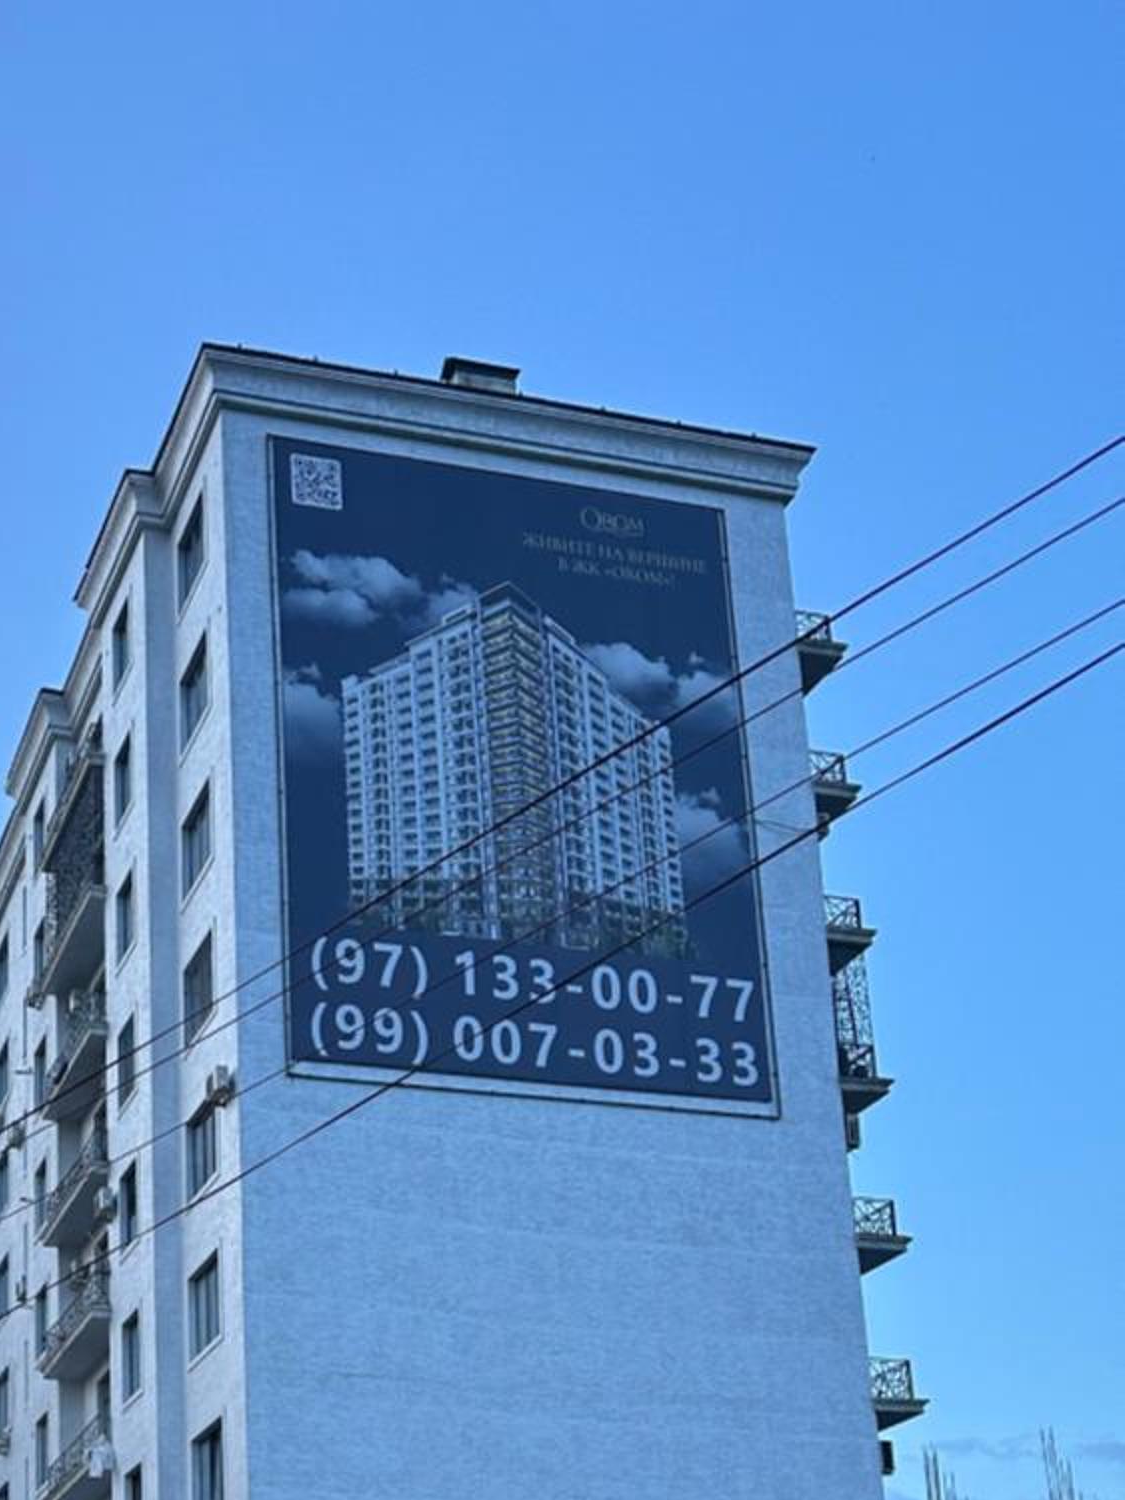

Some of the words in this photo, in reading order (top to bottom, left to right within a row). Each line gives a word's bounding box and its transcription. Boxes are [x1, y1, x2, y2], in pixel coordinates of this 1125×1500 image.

[310, 935, 428, 999] (97)
[455, 949, 754, 1022] 133-00-77
[310, 1002, 429, 1065] (99)
[454, 1015, 759, 1087] 007-03-33
